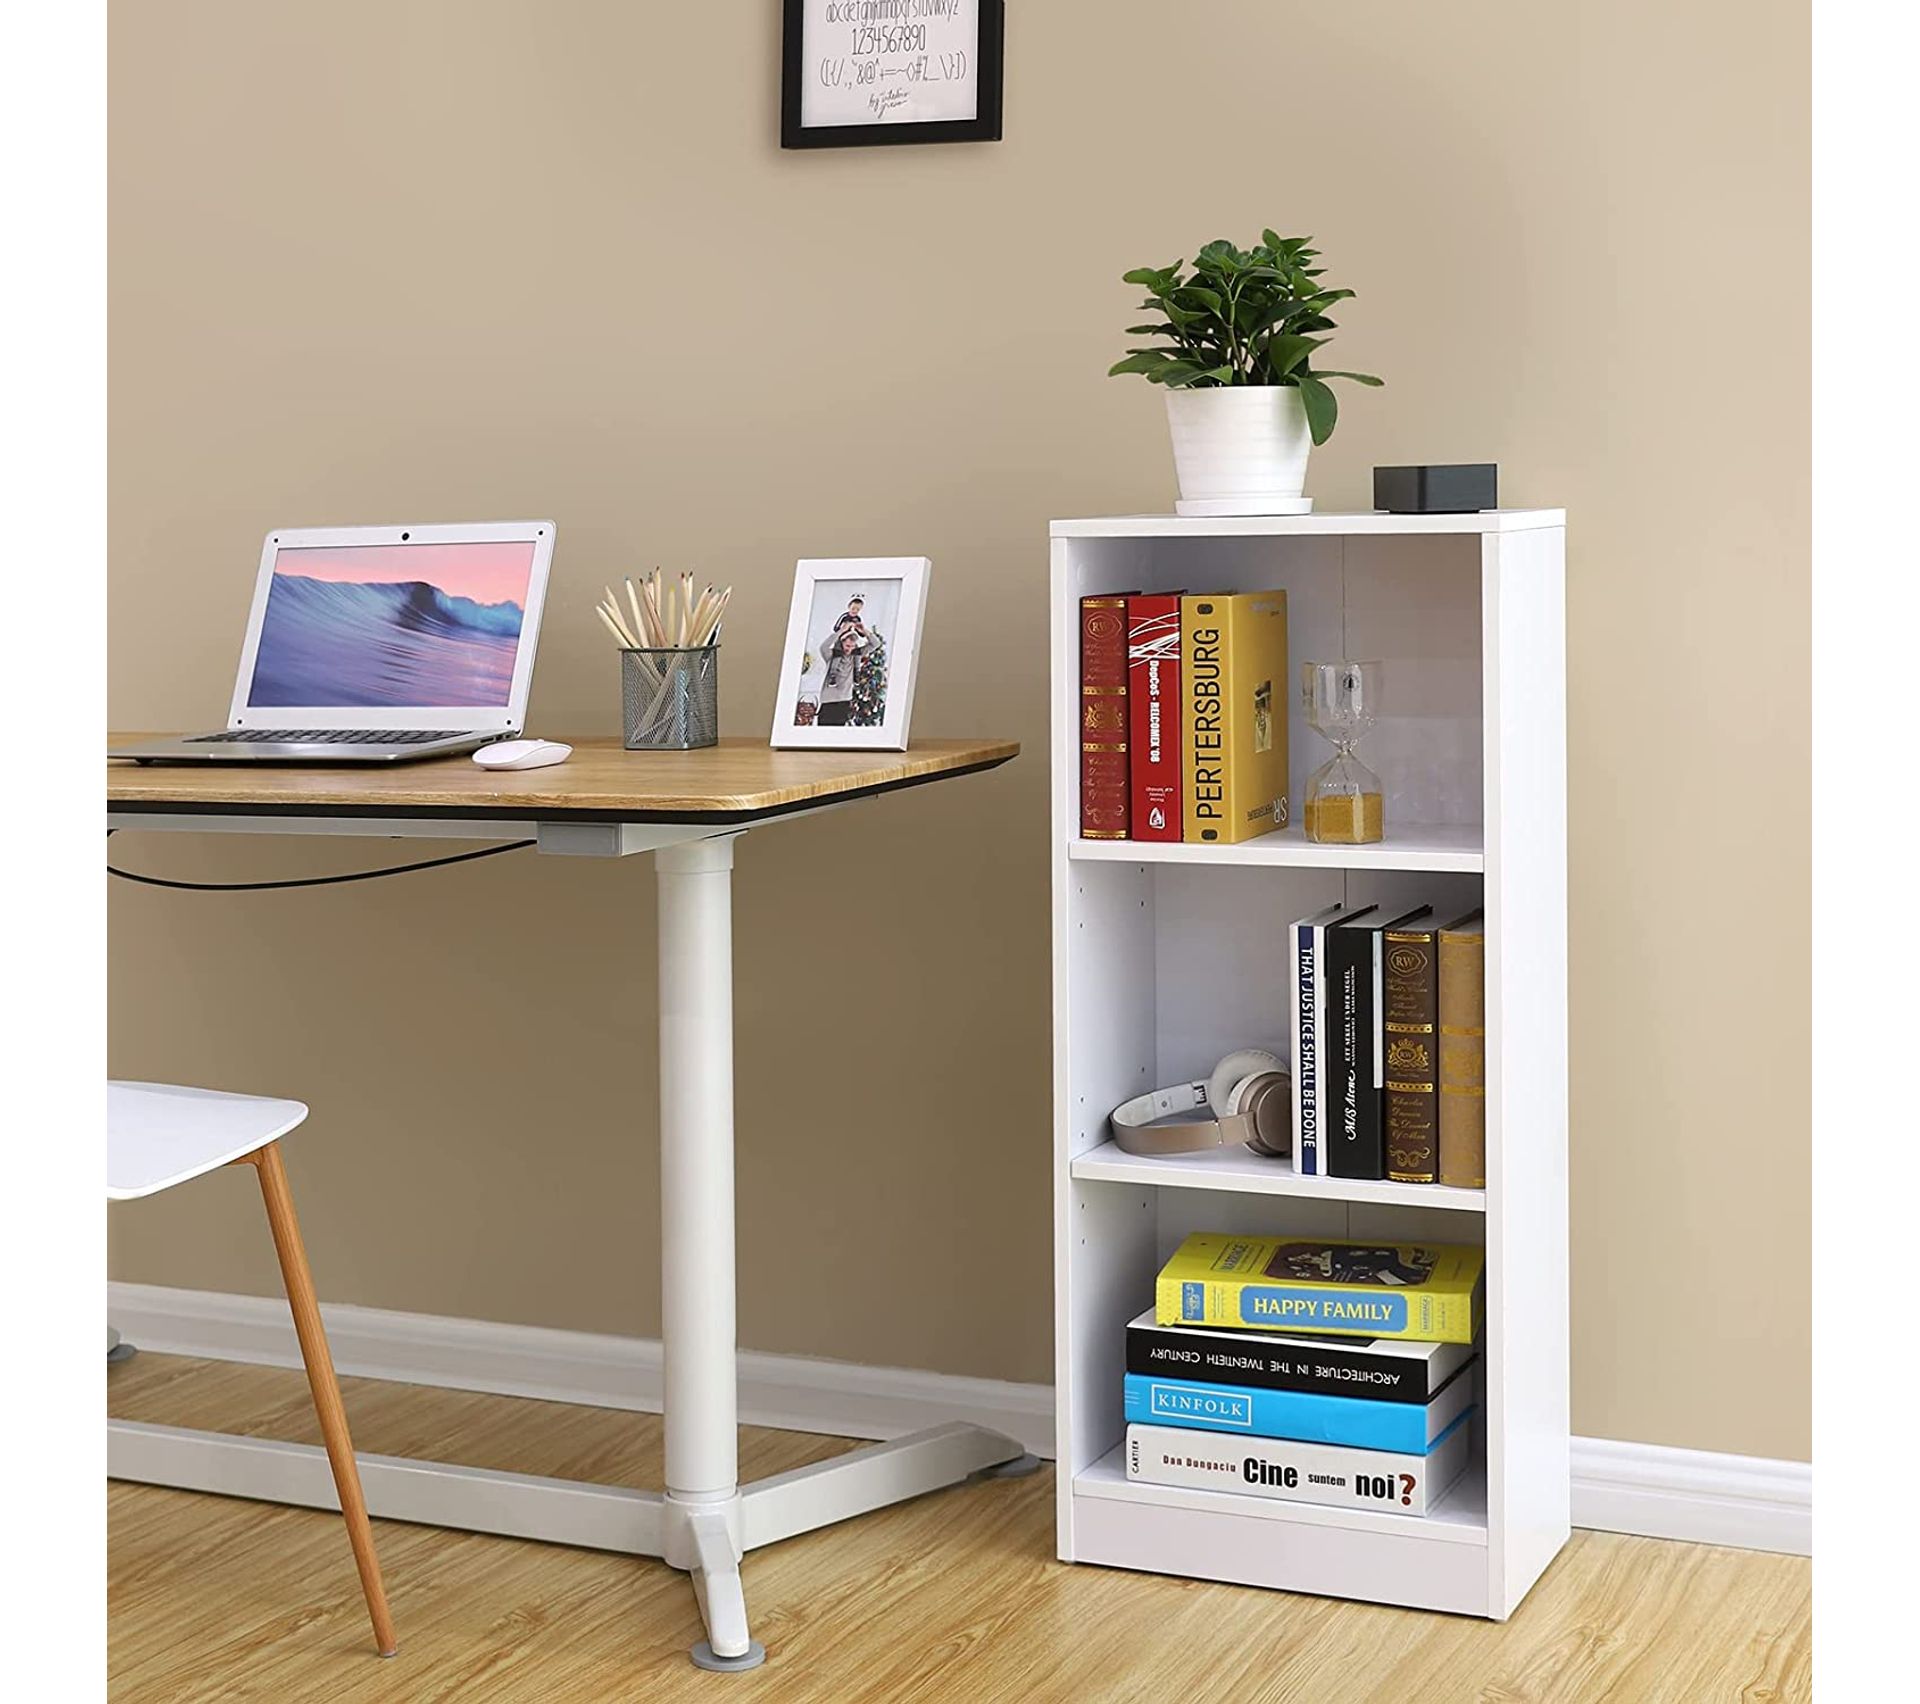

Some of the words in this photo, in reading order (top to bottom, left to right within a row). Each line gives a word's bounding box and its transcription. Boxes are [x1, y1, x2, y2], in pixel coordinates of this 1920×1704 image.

[852, 24, 926, 55] 1234567890
[1193, 628, 1223, 818] PERTERSBURG
[1301, 947, 1314, 982] THAT
[1302, 982, 1314, 1040] JUSTICE
[1302, 1043, 1315, 1086] SHALL
[1303, 1088, 1315, 1107] BE
[1303, 1109, 1316, 1148] DONE
[1253, 1297, 1317, 1318] HAPPY
[1322, 1301, 1394, 1321] FAMILY
[1150, 1348, 1200, 1363] CENTURY
[1206, 1354, 1263, 1370] TWENTIETH
[1270, 1361, 1290, 1373] THE
[1297, 1364, 1309, 1375] IN
[1315, 1365, 1400, 1385] ARCHITECTURE
[1158, 1393, 1243, 1416] KINFOLK
[1163, 1454, 1183, 1466] Dan
[1186, 1457, 1236, 1473] Dungaciu
[1243, 1457, 1298, 1488] Cine
[1308, 1473, 1346, 1487] suntem
